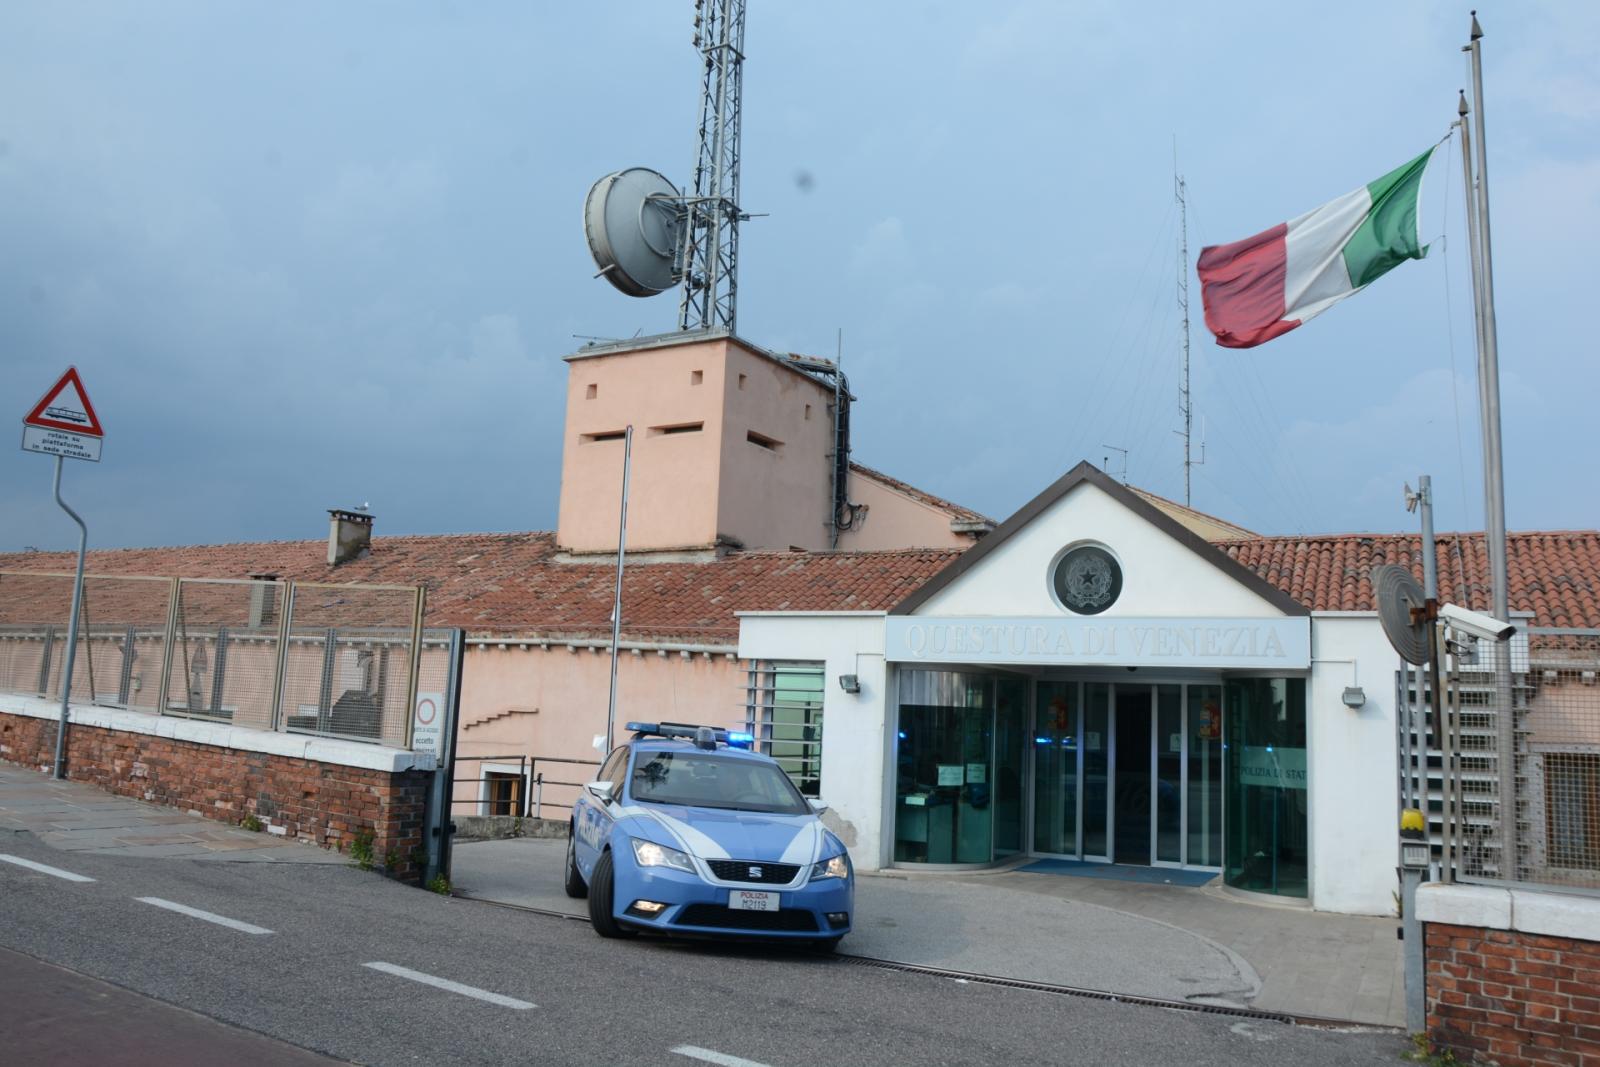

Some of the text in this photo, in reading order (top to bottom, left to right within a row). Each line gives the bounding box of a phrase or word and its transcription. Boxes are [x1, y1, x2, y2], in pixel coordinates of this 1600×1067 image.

[42, 438, 84, 450] piattaforma
[63, 448, 92, 458] stradale
[905, 623, 1288, 659] QUESTURA DI VENEZIA
[1286, 768, 1306, 780] STAT
[740, 891, 769, 900] POLIZIA
[742, 899, 768, 910] M2119
